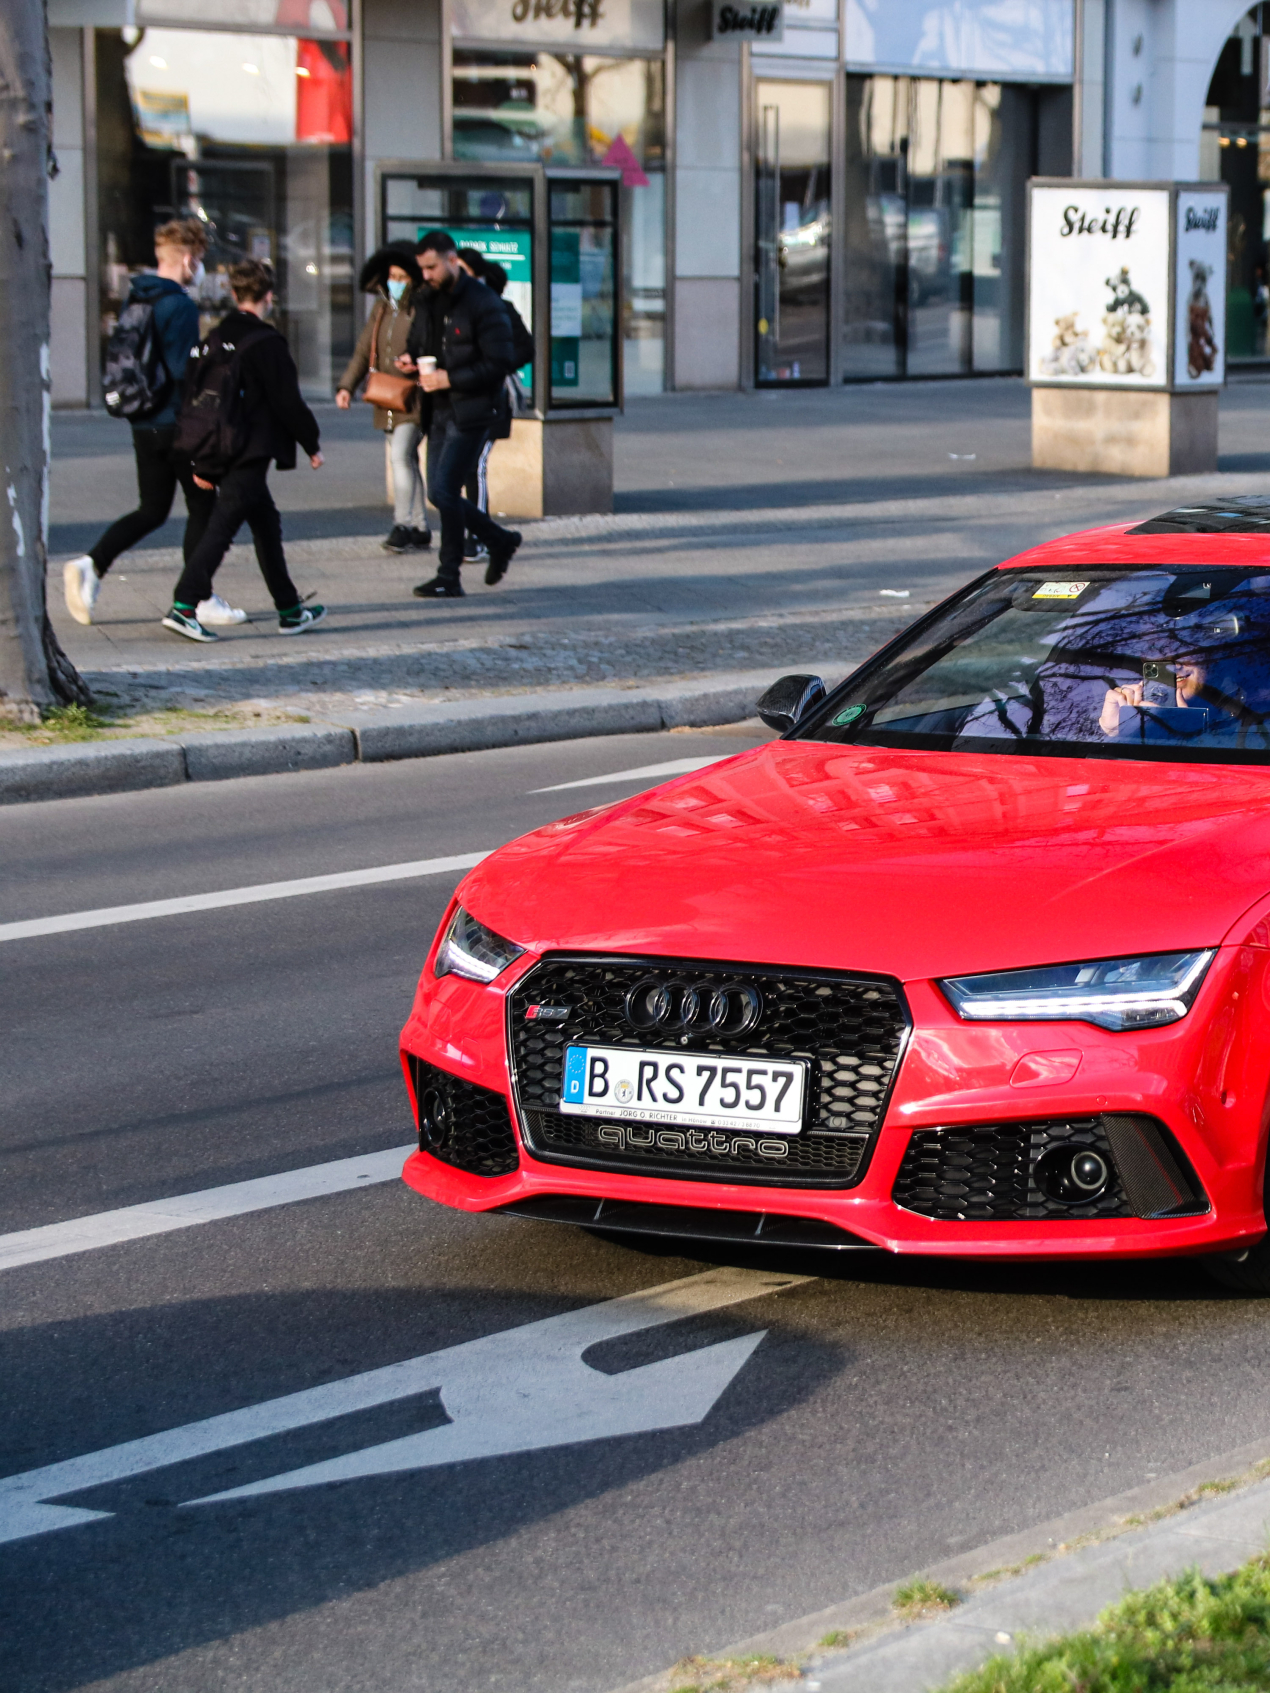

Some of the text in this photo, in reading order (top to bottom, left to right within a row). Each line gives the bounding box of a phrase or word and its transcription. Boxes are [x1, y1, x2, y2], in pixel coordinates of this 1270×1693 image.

[719, 6, 779, 34] Steiff
[1060, 205, 1140, 240] Steiff
[1185, 206, 1220, 233] Steiff
[570, 1080, 579, 1094] D
[588, 1056, 795, 1114] B RS 7557
[649, 1112, 678, 1121] RICHTER
[598, 1125, 790, 1158] quattro
